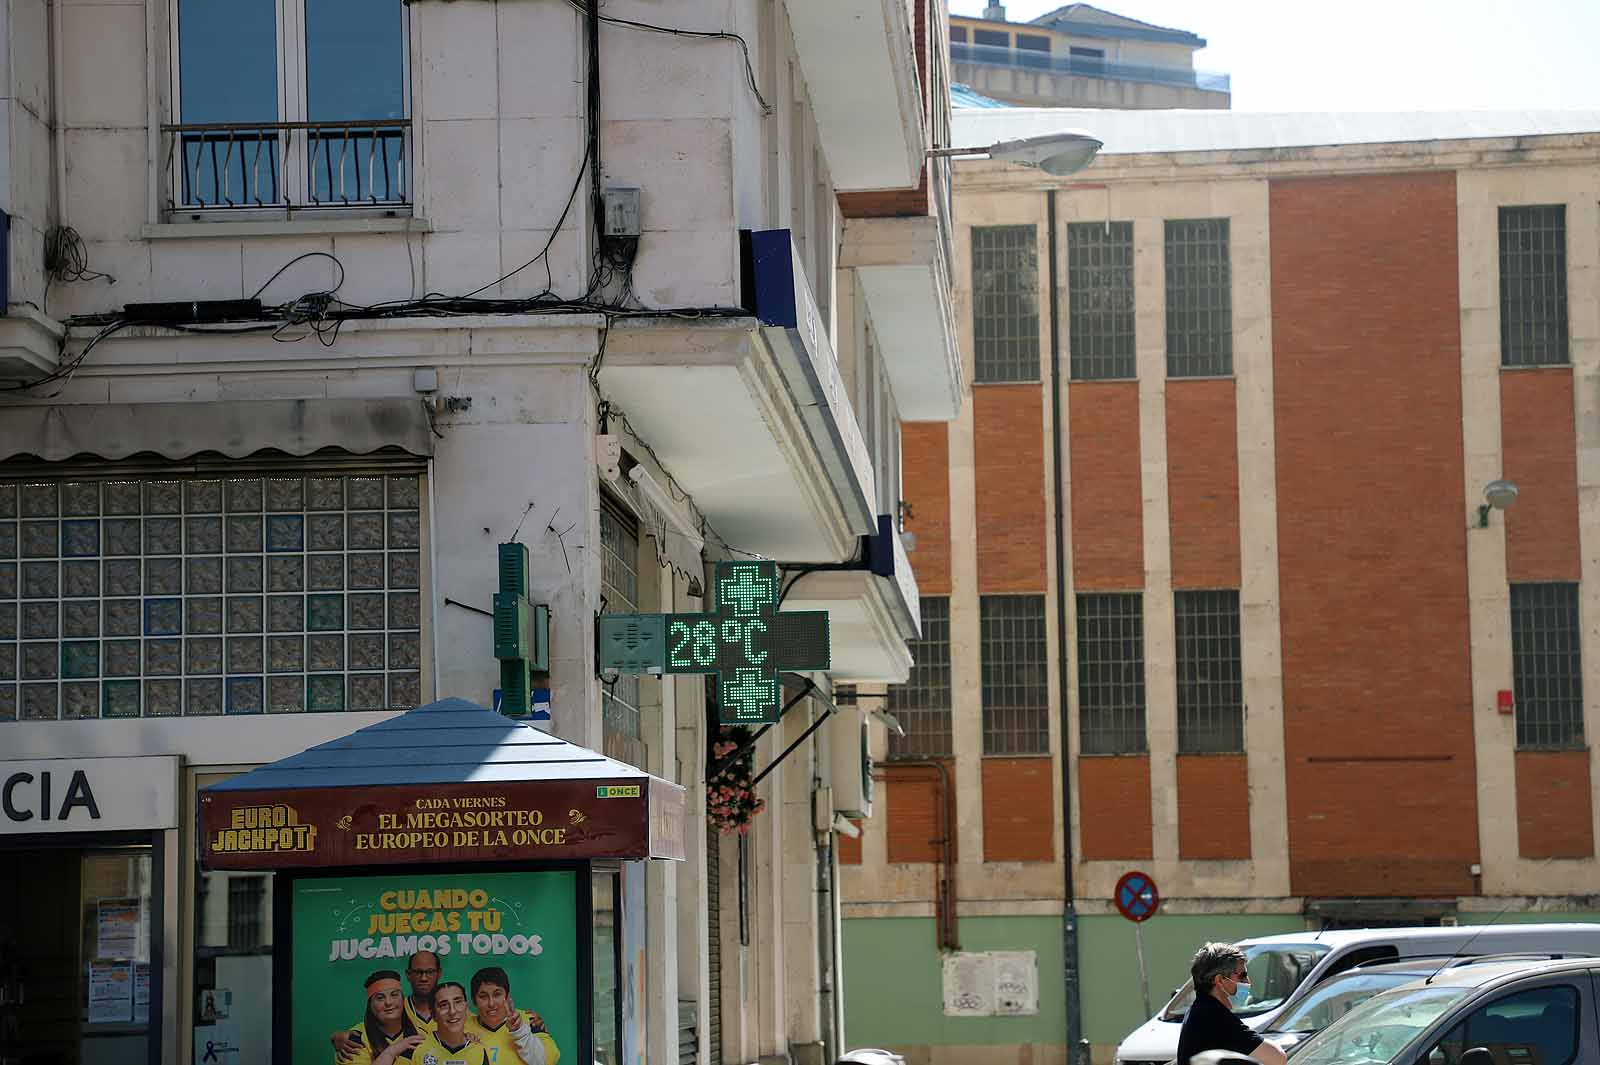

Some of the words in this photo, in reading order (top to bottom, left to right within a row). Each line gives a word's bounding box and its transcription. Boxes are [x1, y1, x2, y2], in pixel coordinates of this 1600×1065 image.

[609, 787, 639, 796] ONCE
[415, 799, 450, 810] CADA
[453, 797, 506, 808] VIERNES
[231, 804, 298, 829] EURO
[379, 814, 402, 830] EL
[406, 810, 543, 829] MEGASORTEO
[211, 826, 316, 852] JACKPOT
[356, 832, 449, 849] EUROPEO
[453, 831, 480, 847] DE
[483, 830, 508, 846] LA
[512, 828, 566, 845] ONCE
[380, 889, 488, 911] CUANDO
[368, 912, 461, 935] JUEGAS
[329, 934, 452, 962] JUGAMOS
[457, 933, 543, 956] TODOS
[490, 1048, 499, 1062] 7
